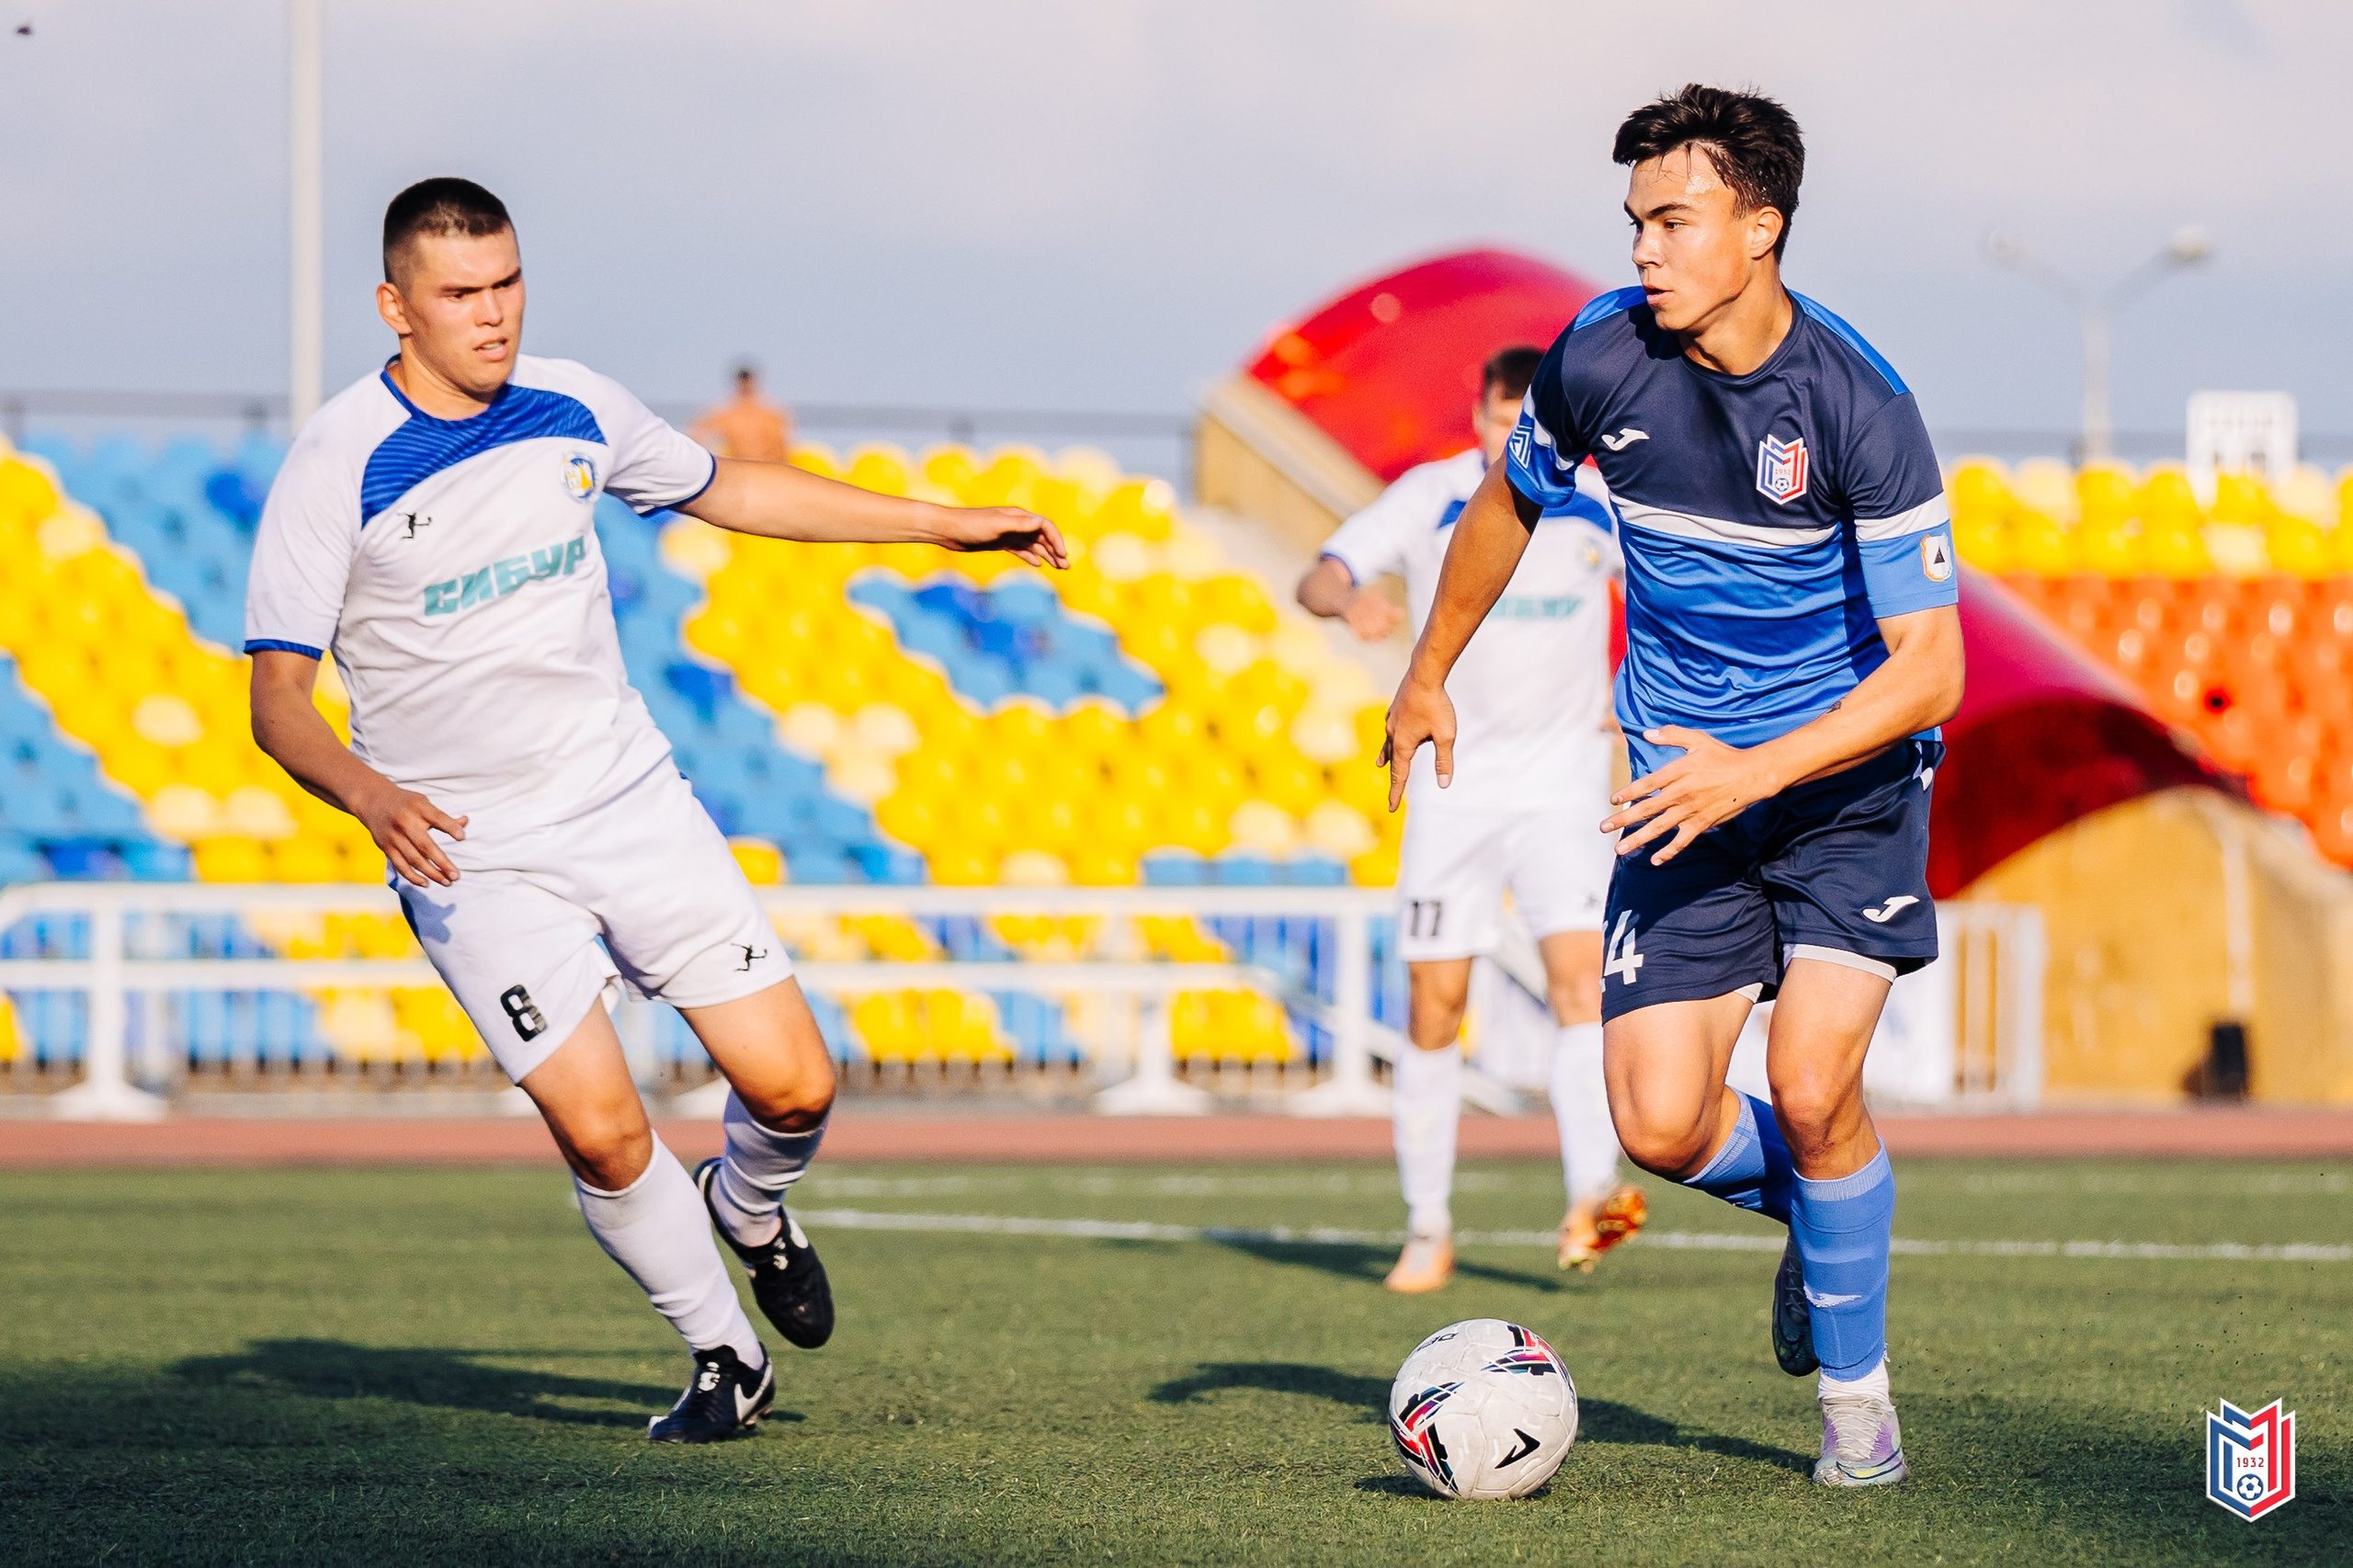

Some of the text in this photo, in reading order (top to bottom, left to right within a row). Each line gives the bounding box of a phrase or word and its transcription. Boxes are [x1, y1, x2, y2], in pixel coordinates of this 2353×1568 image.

[424, 535, 586, 617] СИБУР
[1599, 909, 1644, 994] 4
[499, 983, 549, 1042] 8
